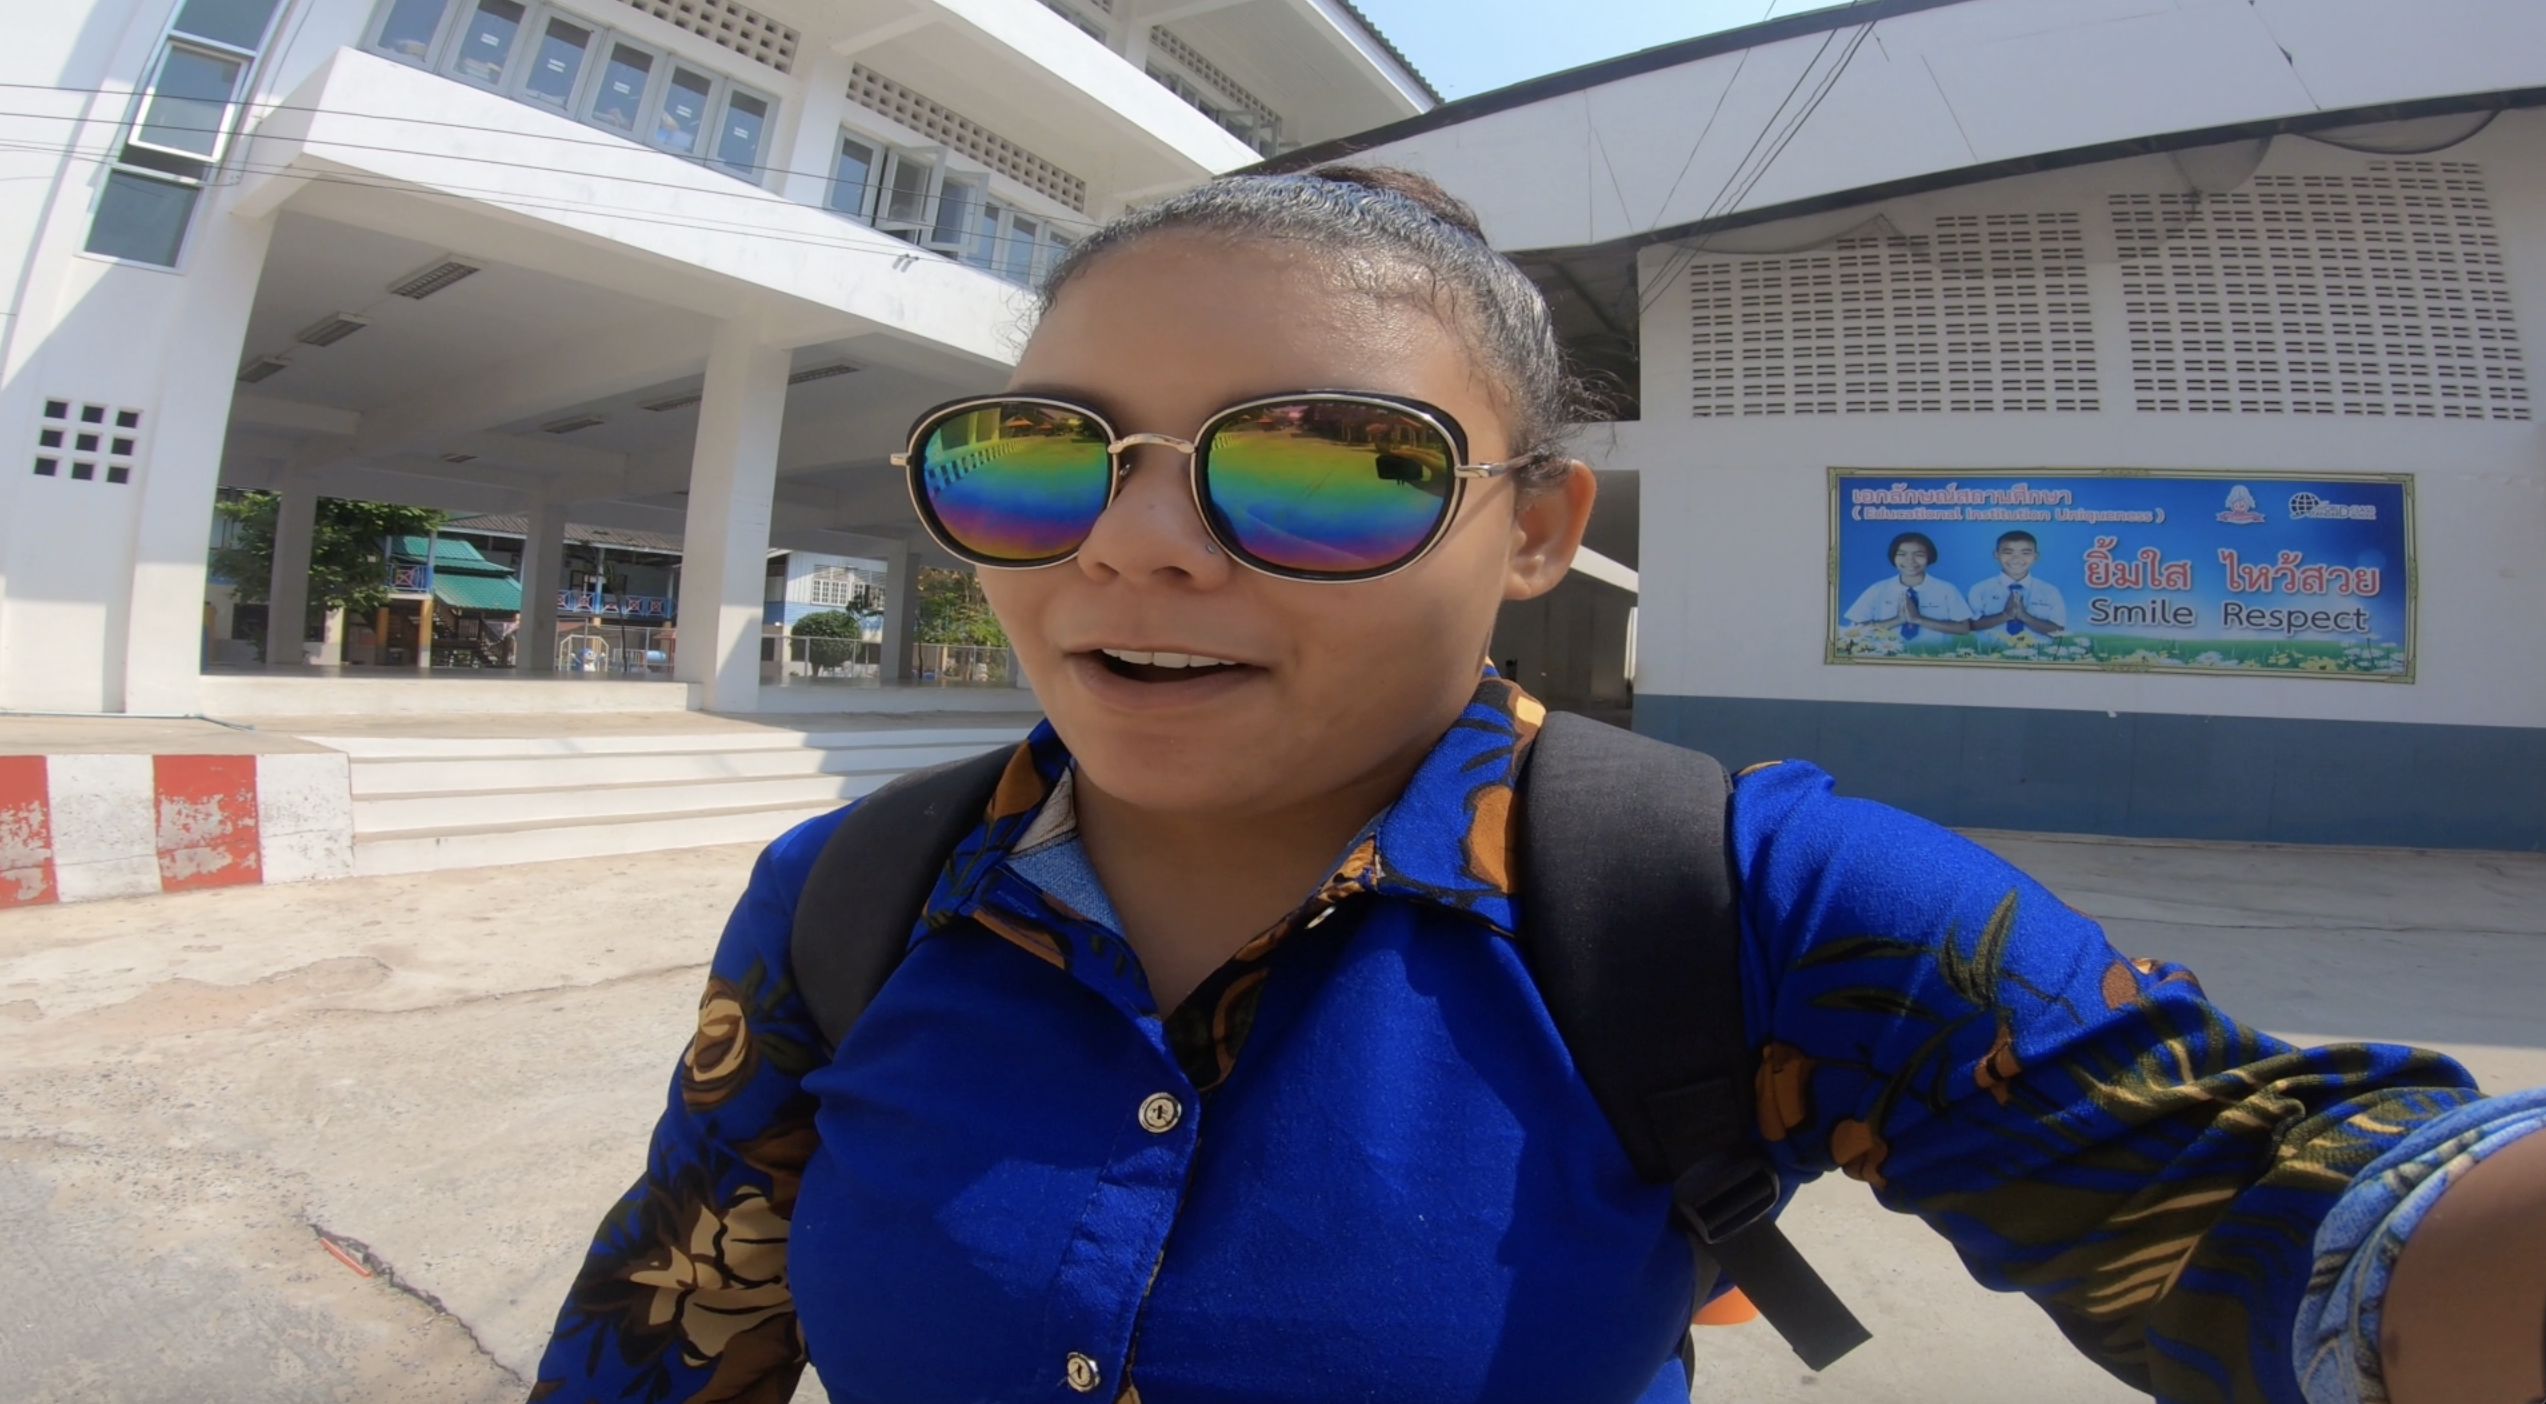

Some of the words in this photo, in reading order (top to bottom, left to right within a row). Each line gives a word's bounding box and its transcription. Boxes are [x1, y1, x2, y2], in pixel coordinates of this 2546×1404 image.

[1853, 484, 2071, 504] เอกลักษณ์สถานศึกษา
[1864, 506, 1962, 520] Educational
[1967, 507, 2051, 521] Institution
[2055, 508, 2153, 524] Uniqueness
[2084, 536, 2191, 589] ยิ้มใส
[2218, 549, 2380, 595] ไหว้สวย
[2090, 598, 2194, 624] Smile
[2222, 602, 2368, 633] Respect
